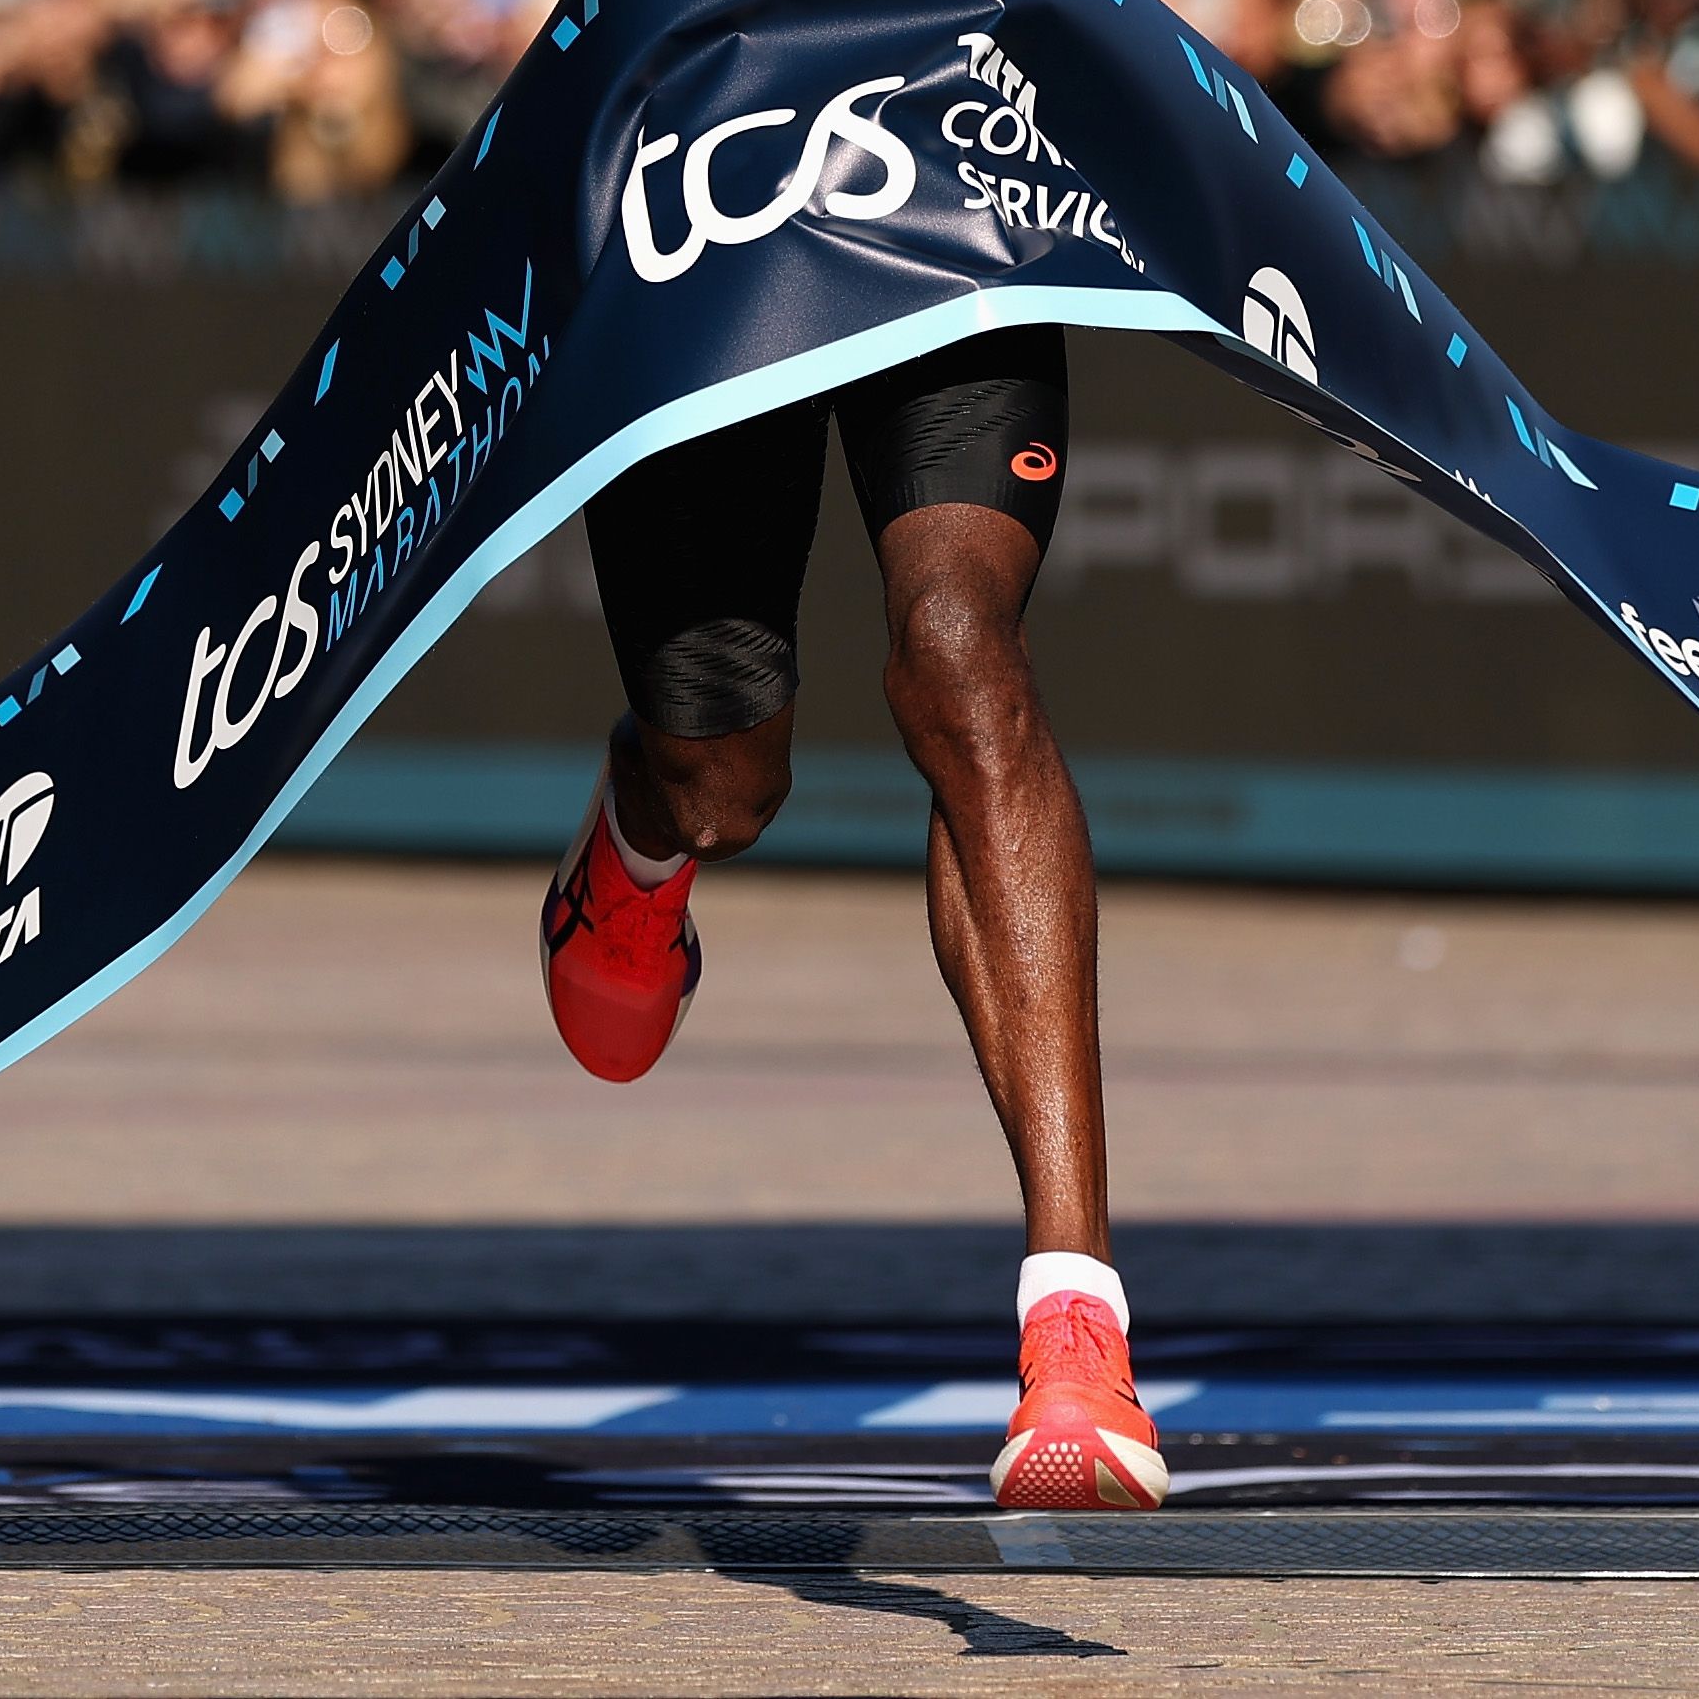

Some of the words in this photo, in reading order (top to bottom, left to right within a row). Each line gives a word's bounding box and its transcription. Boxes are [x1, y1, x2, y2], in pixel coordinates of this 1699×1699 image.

[621, 75, 916, 282] tcs
[957, 32, 1037, 127] TATA
[173, 541, 319, 789] tcs
[328, 348, 463, 584] SYDNEY
